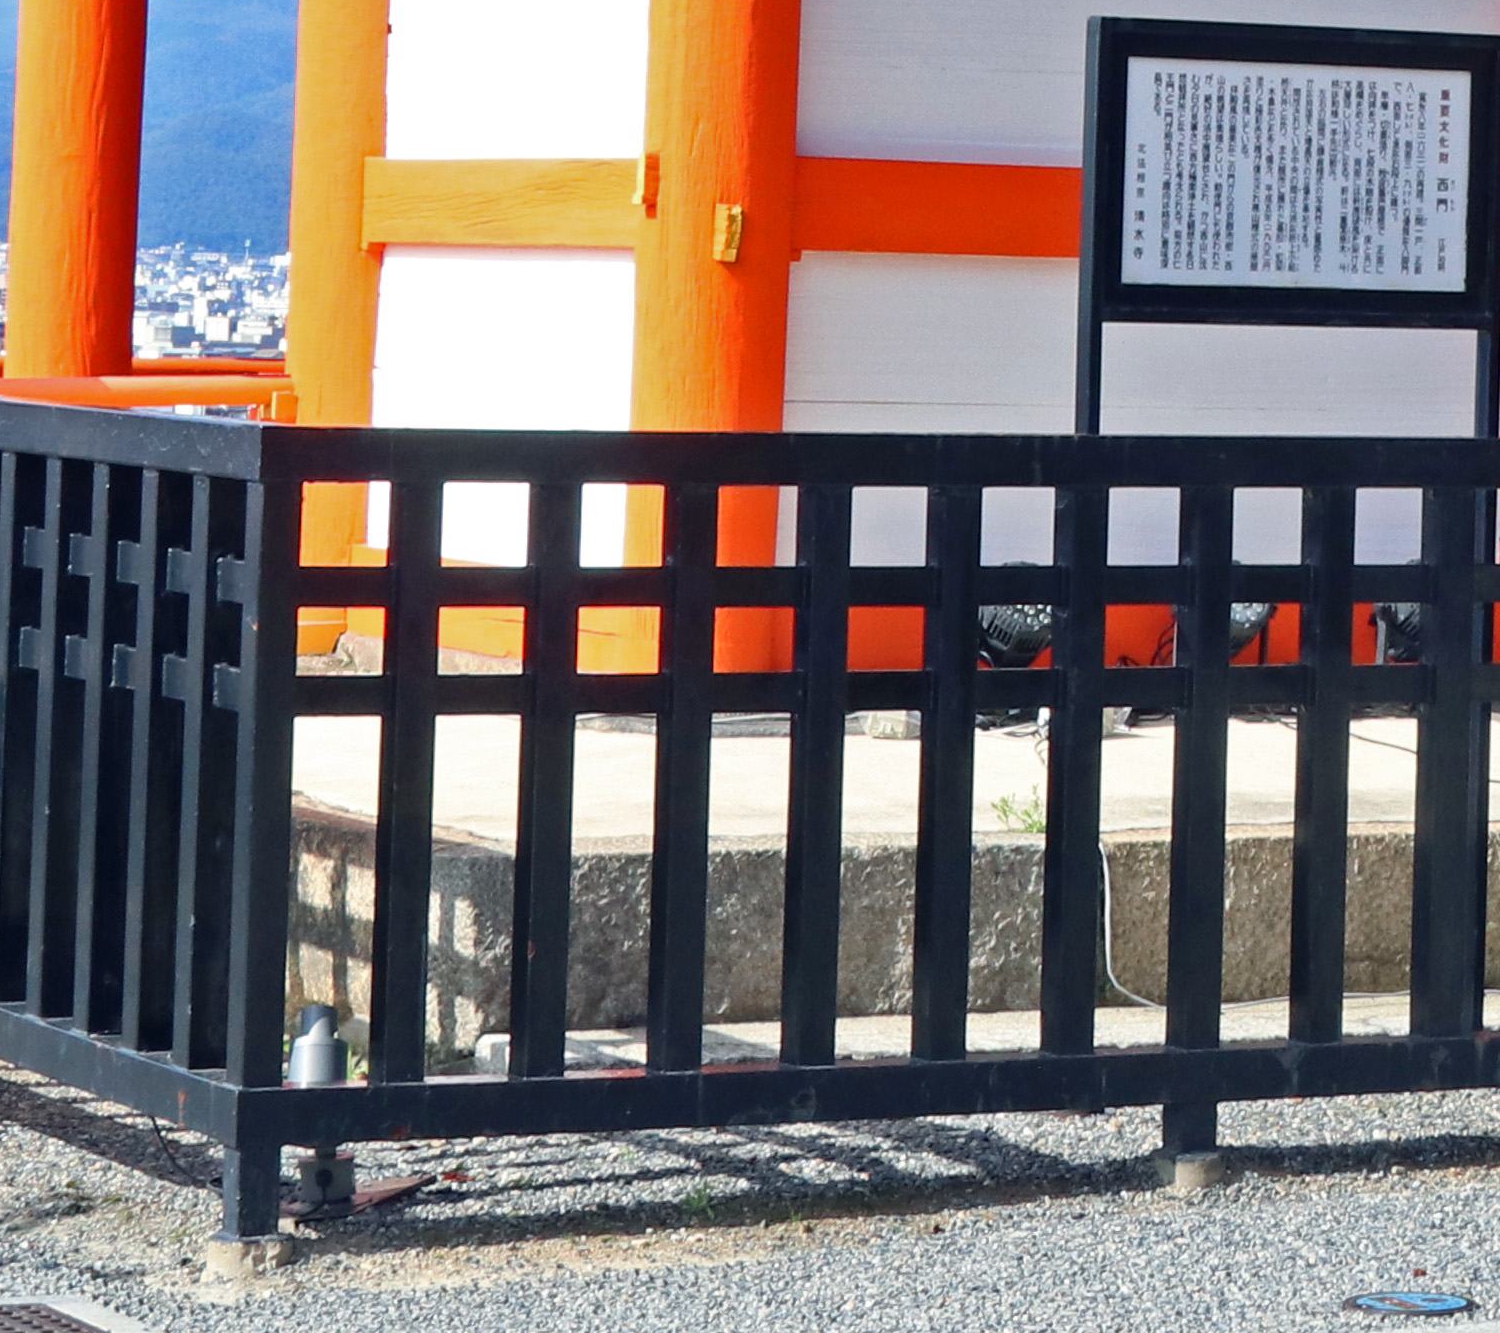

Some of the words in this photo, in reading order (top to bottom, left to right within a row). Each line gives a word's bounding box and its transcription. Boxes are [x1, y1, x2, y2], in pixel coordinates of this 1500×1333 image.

[1437, 88, 1451, 164] 重要文化財
[1435, 177, 1449, 213] 西門
[1132, 208, 1145, 260] 清水寺
